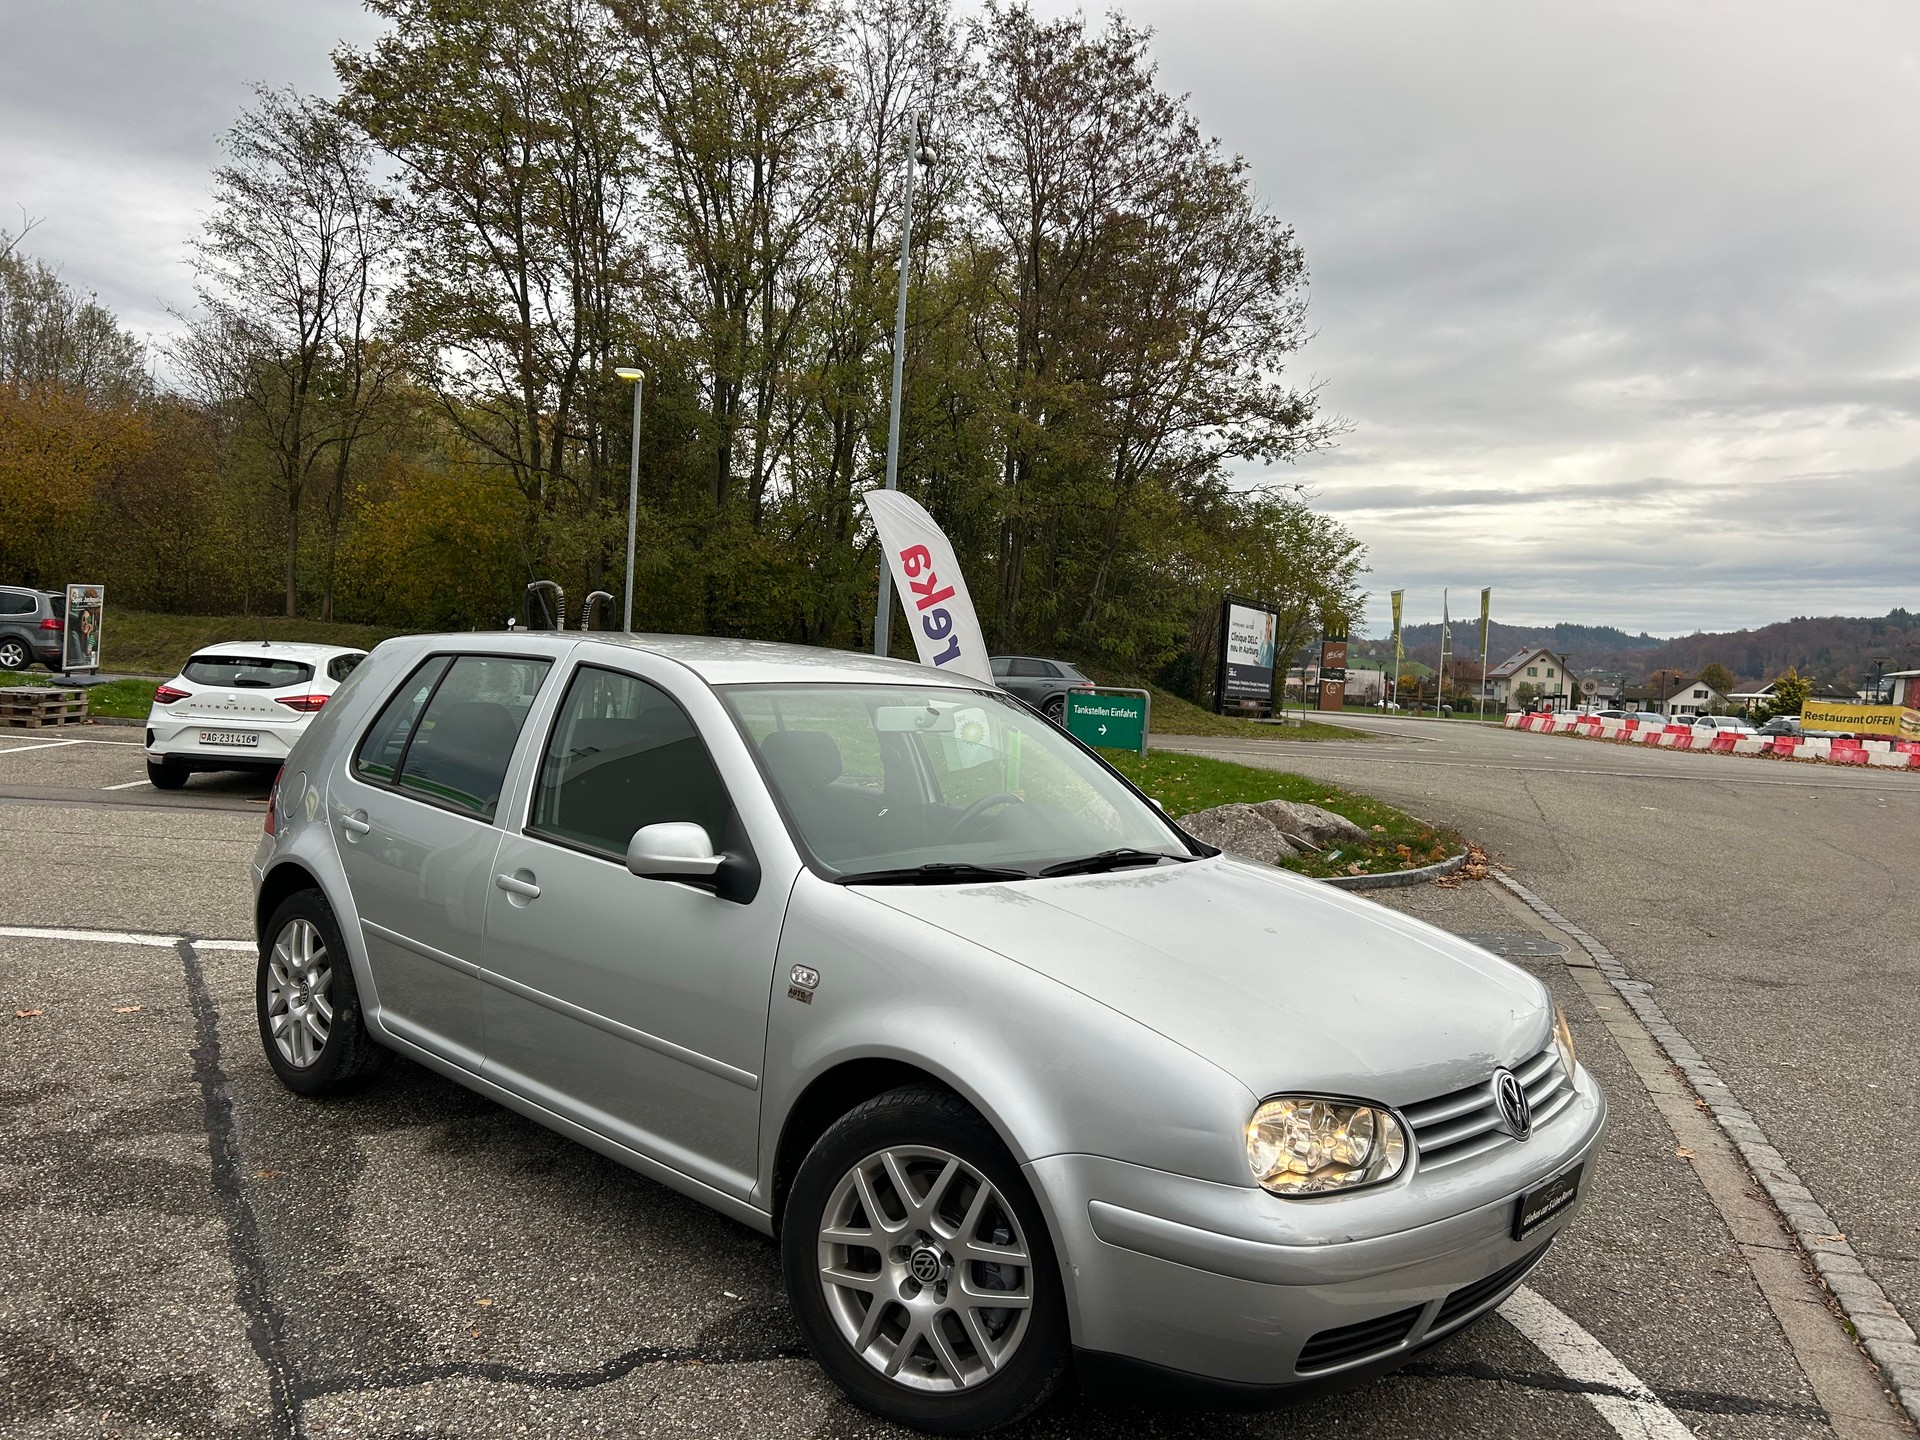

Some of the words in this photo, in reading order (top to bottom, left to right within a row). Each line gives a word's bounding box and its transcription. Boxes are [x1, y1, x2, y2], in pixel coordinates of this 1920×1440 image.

[900, 544, 961, 667] reka
[1231, 632, 1247, 644] Clinique
[190, 703, 273, 712] MITSUBISHI
[1074, 705, 1109, 716] Tankstellen
[1111, 708, 1137, 718] Einfahrt
[1804, 711, 1864, 724] Restaurant
[1865, 715, 1895, 725] OFFEN
